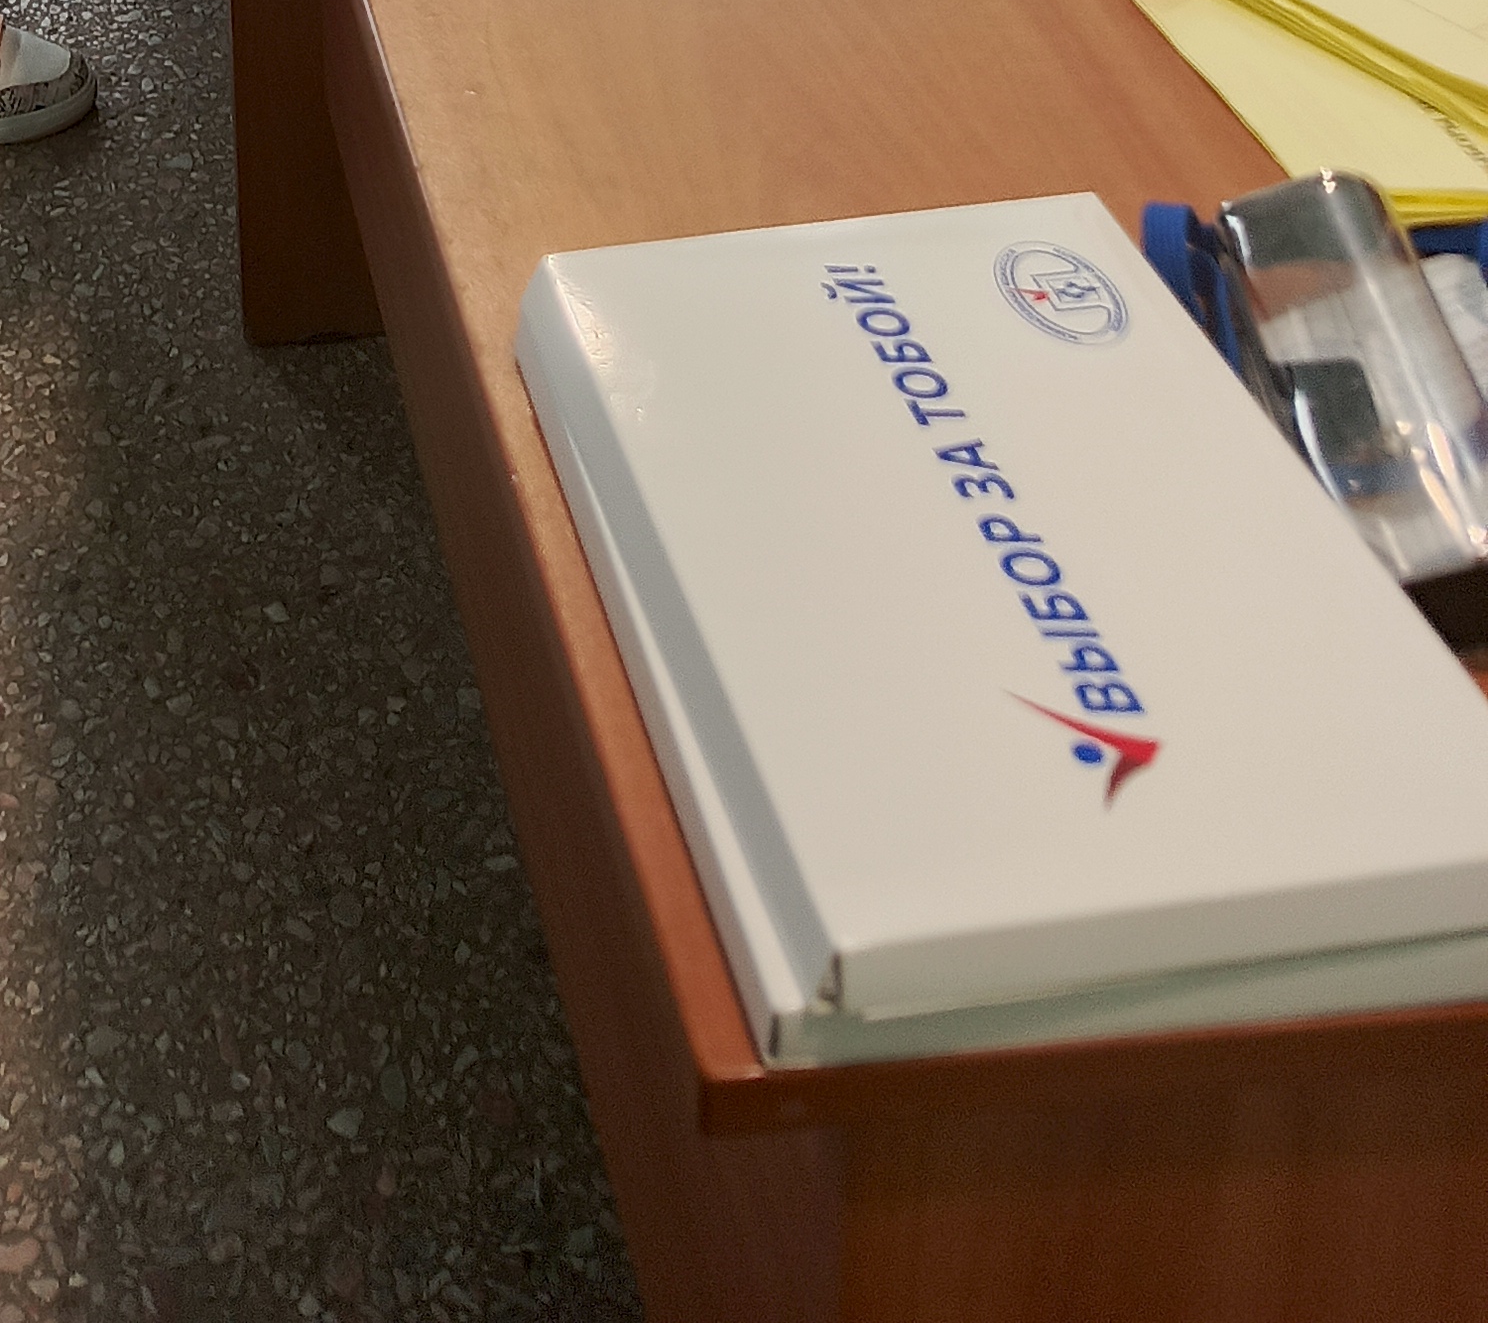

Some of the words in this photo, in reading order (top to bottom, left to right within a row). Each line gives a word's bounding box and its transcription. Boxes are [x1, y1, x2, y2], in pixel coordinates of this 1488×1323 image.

[820, 264, 966, 426] ТОБОЙ!
[933, 437, 1015, 500] ЗА
[976, 512, 1146, 713] ВЫБОР
